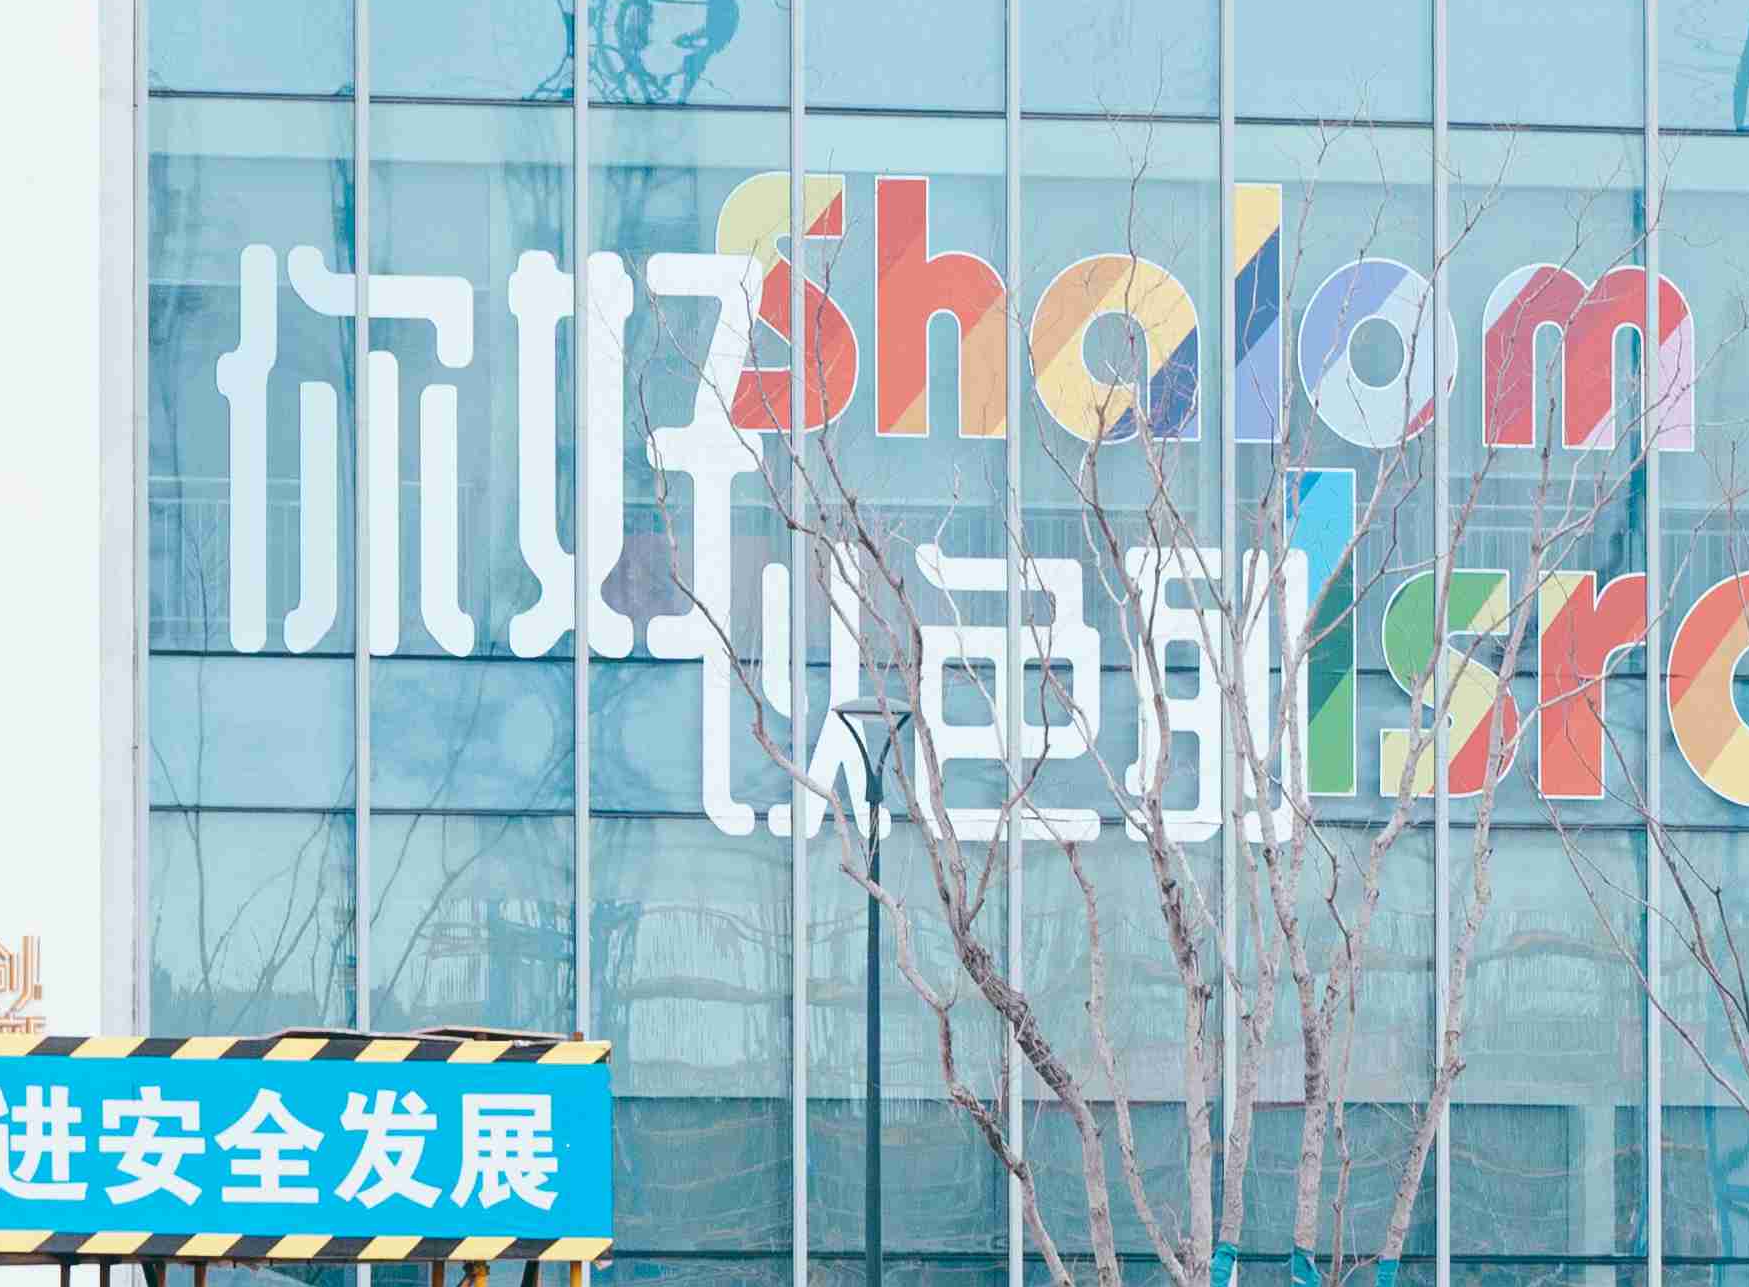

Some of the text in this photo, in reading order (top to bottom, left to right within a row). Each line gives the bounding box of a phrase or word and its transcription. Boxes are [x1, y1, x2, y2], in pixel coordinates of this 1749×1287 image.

[215, 241, 766, 660] 你好
[715, 169, 1697, 454] Shalom
[702, 540, 1308, 844] 以色列
